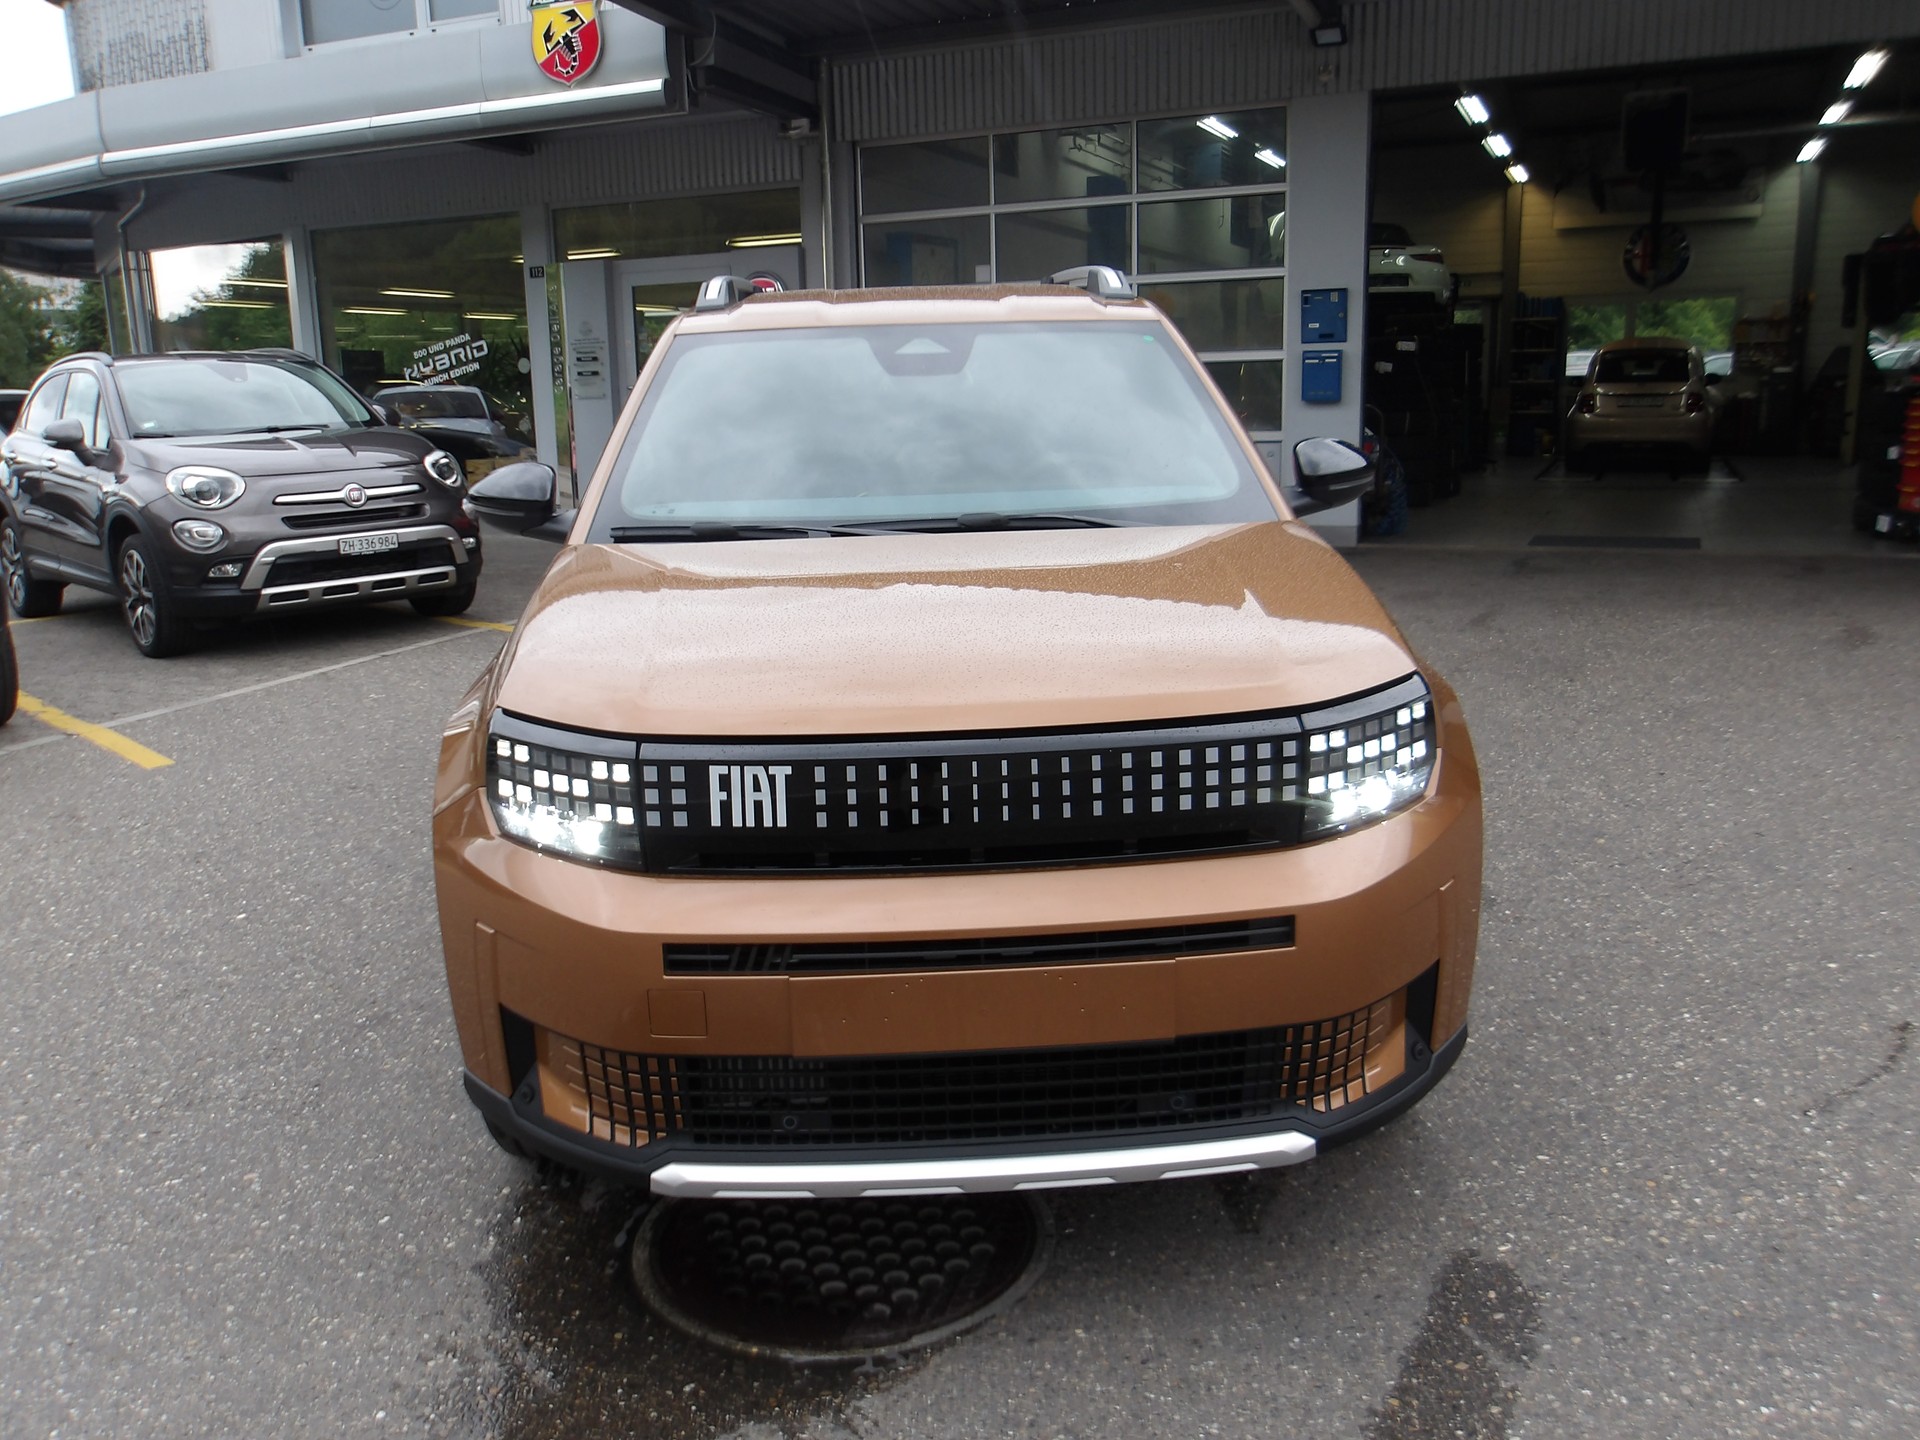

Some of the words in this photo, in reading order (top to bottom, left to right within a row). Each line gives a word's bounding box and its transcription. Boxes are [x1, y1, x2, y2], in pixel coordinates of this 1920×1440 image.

[531, 267, 543, 277] 112
[403, 339, 489, 381] HYBRID
[413, 348, 428, 360] 500
[428, 342, 445, 354] UND
[445, 333, 471, 348] PANDA
[449, 361, 480, 379] EDITION
[553, 347, 564, 394] Garage
[708, 765, 792, 828] FIAT
